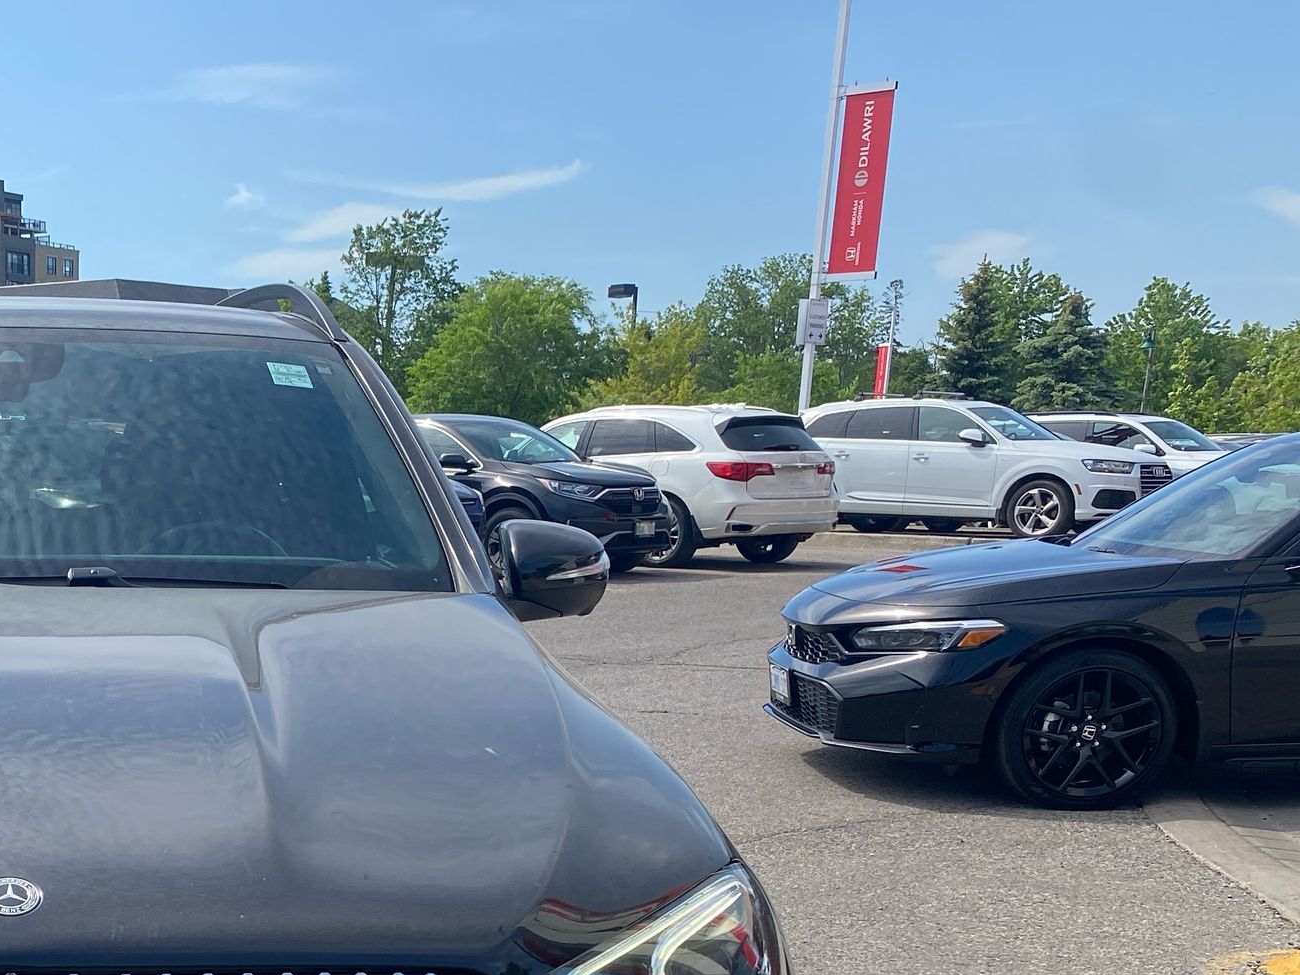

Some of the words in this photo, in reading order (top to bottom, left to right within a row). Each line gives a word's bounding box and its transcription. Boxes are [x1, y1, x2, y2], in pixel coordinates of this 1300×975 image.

[858, 100, 875, 168] DILAWRI
[850, 200, 859, 237] MARKHAM
[856, 199, 865, 226] HONDA
